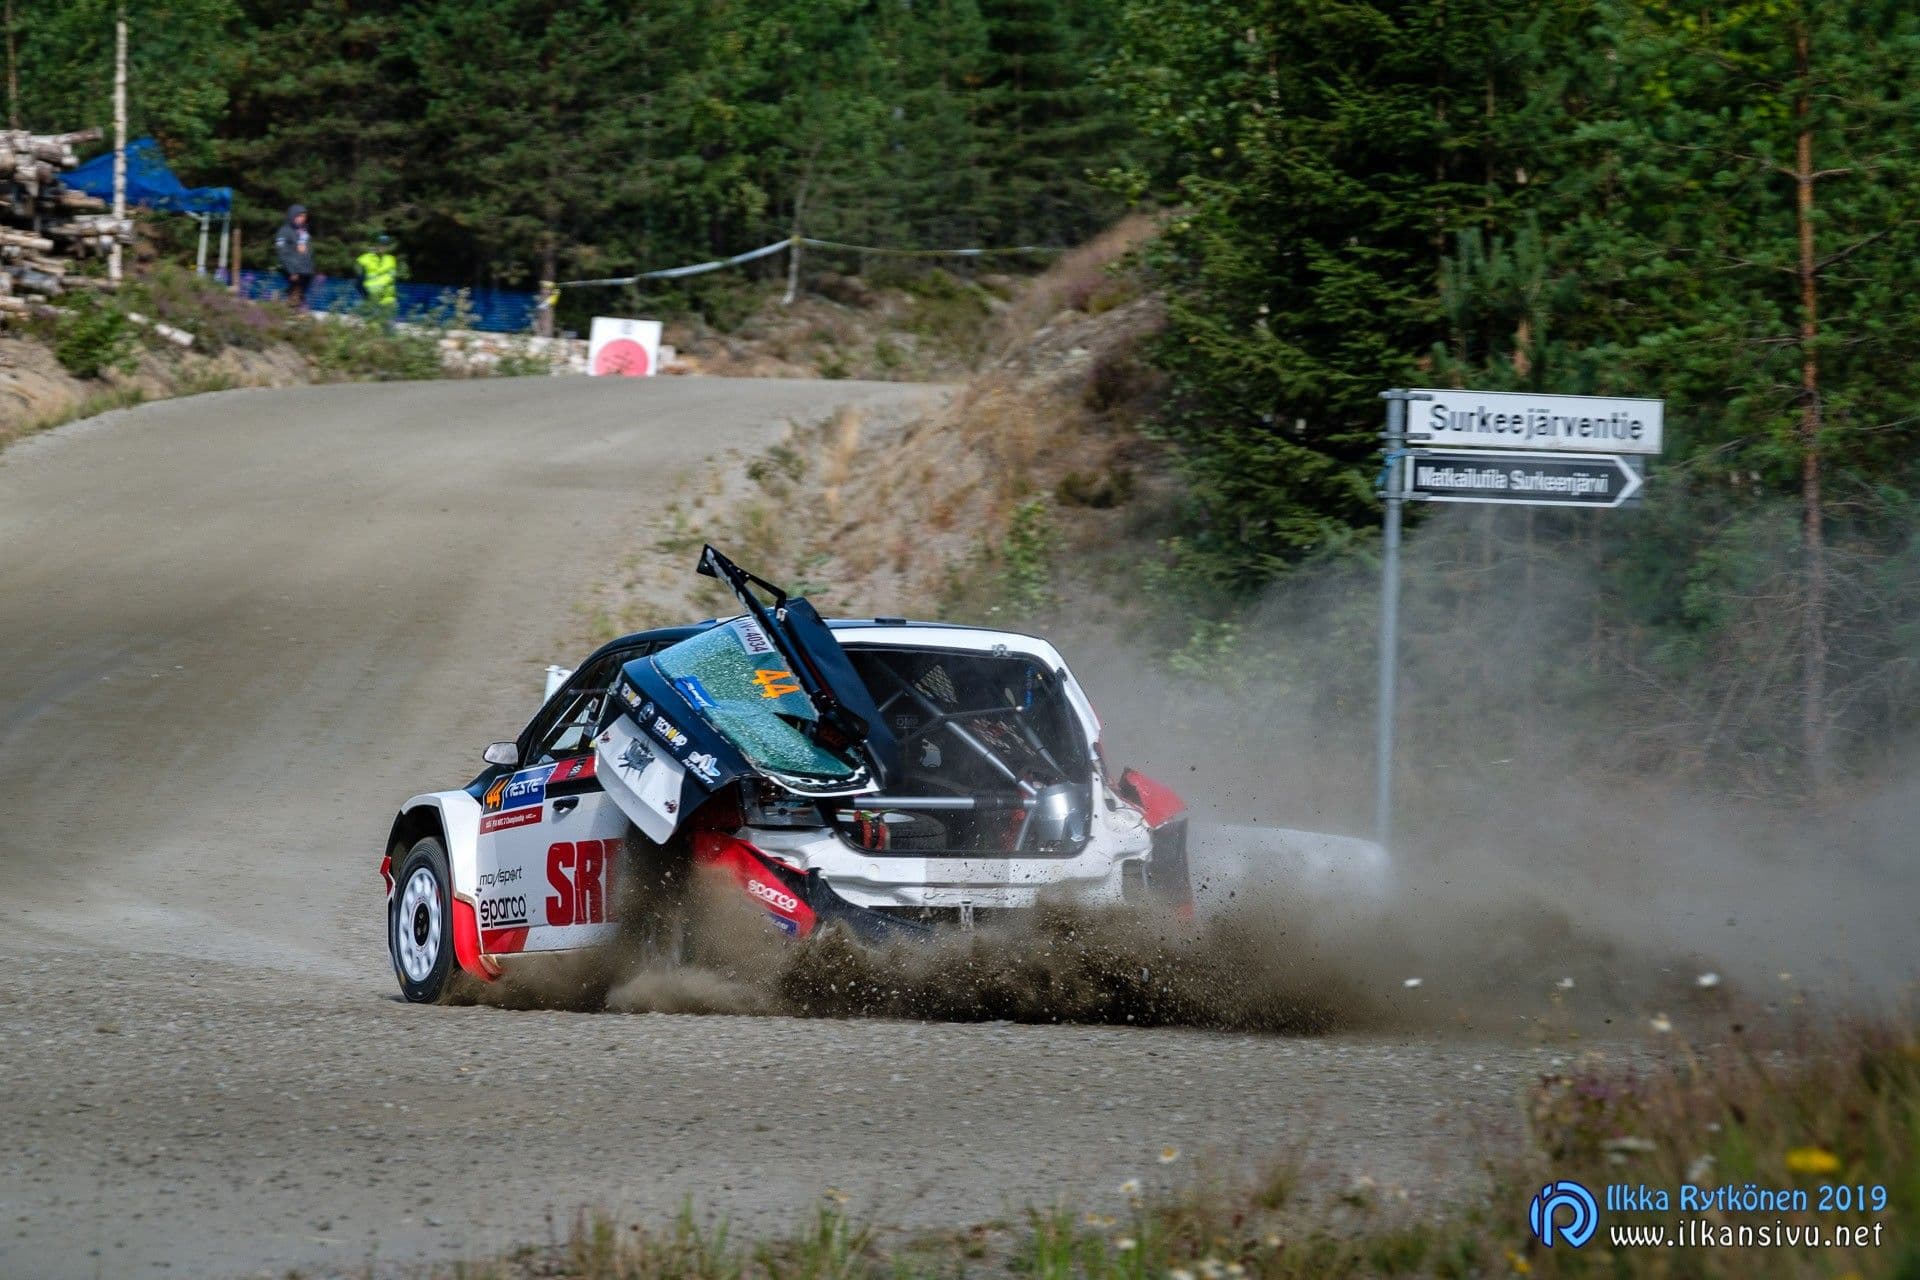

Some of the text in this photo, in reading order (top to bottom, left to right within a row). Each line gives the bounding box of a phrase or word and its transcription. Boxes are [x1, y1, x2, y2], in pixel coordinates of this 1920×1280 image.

[1430, 403, 1645, 440] Surkeejärventie
[752, 669, 800, 699] 44
[486, 779, 509, 809] 44
[505, 777, 544, 798] NESTE
[748, 880, 798, 912] sparco
[480, 896, 526, 928] sparco
